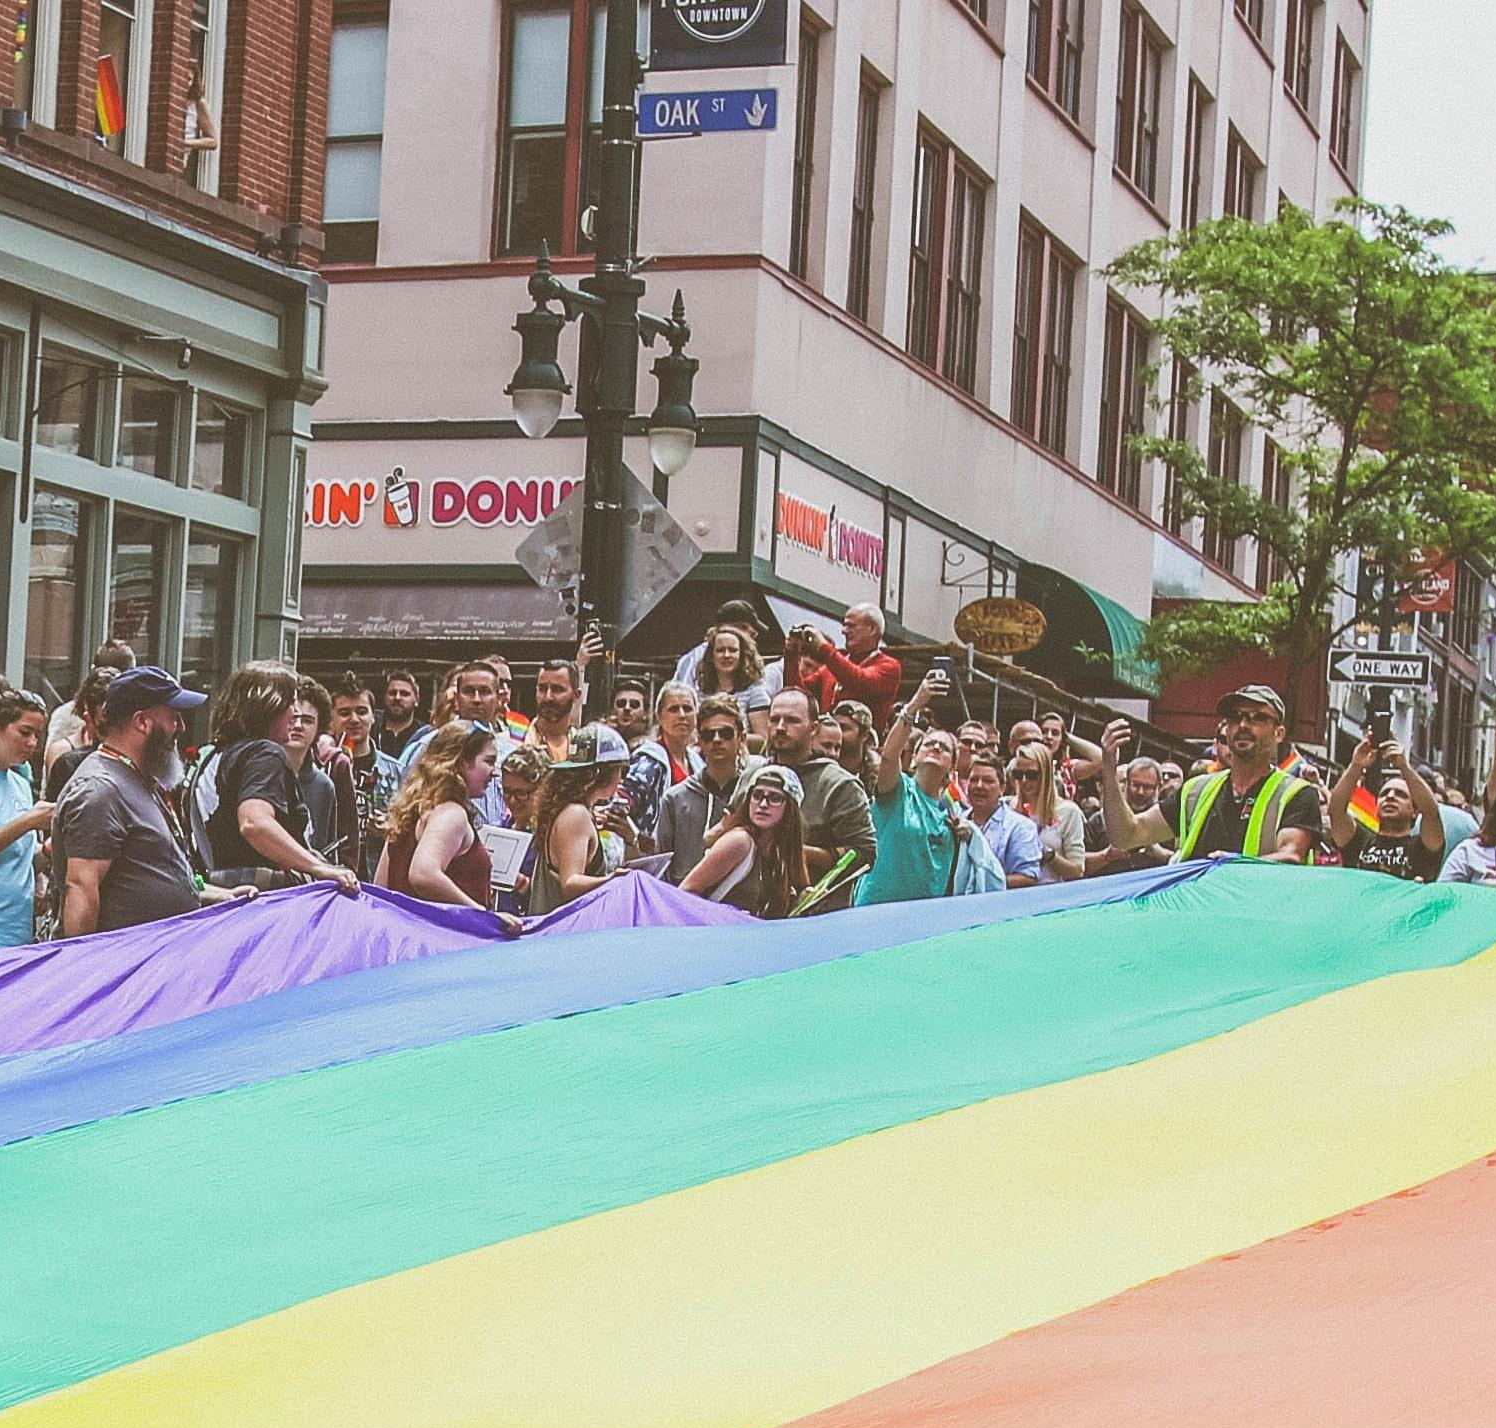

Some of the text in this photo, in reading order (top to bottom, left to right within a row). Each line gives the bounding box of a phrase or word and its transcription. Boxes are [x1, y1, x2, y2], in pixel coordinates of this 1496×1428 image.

[689, 7, 748, 23] DOWNTOWN
[655, 98, 725, 127] OAK ST
[305, 480, 584, 524] IN' DONU
[1353, 660, 1420, 676] ONE WAY
